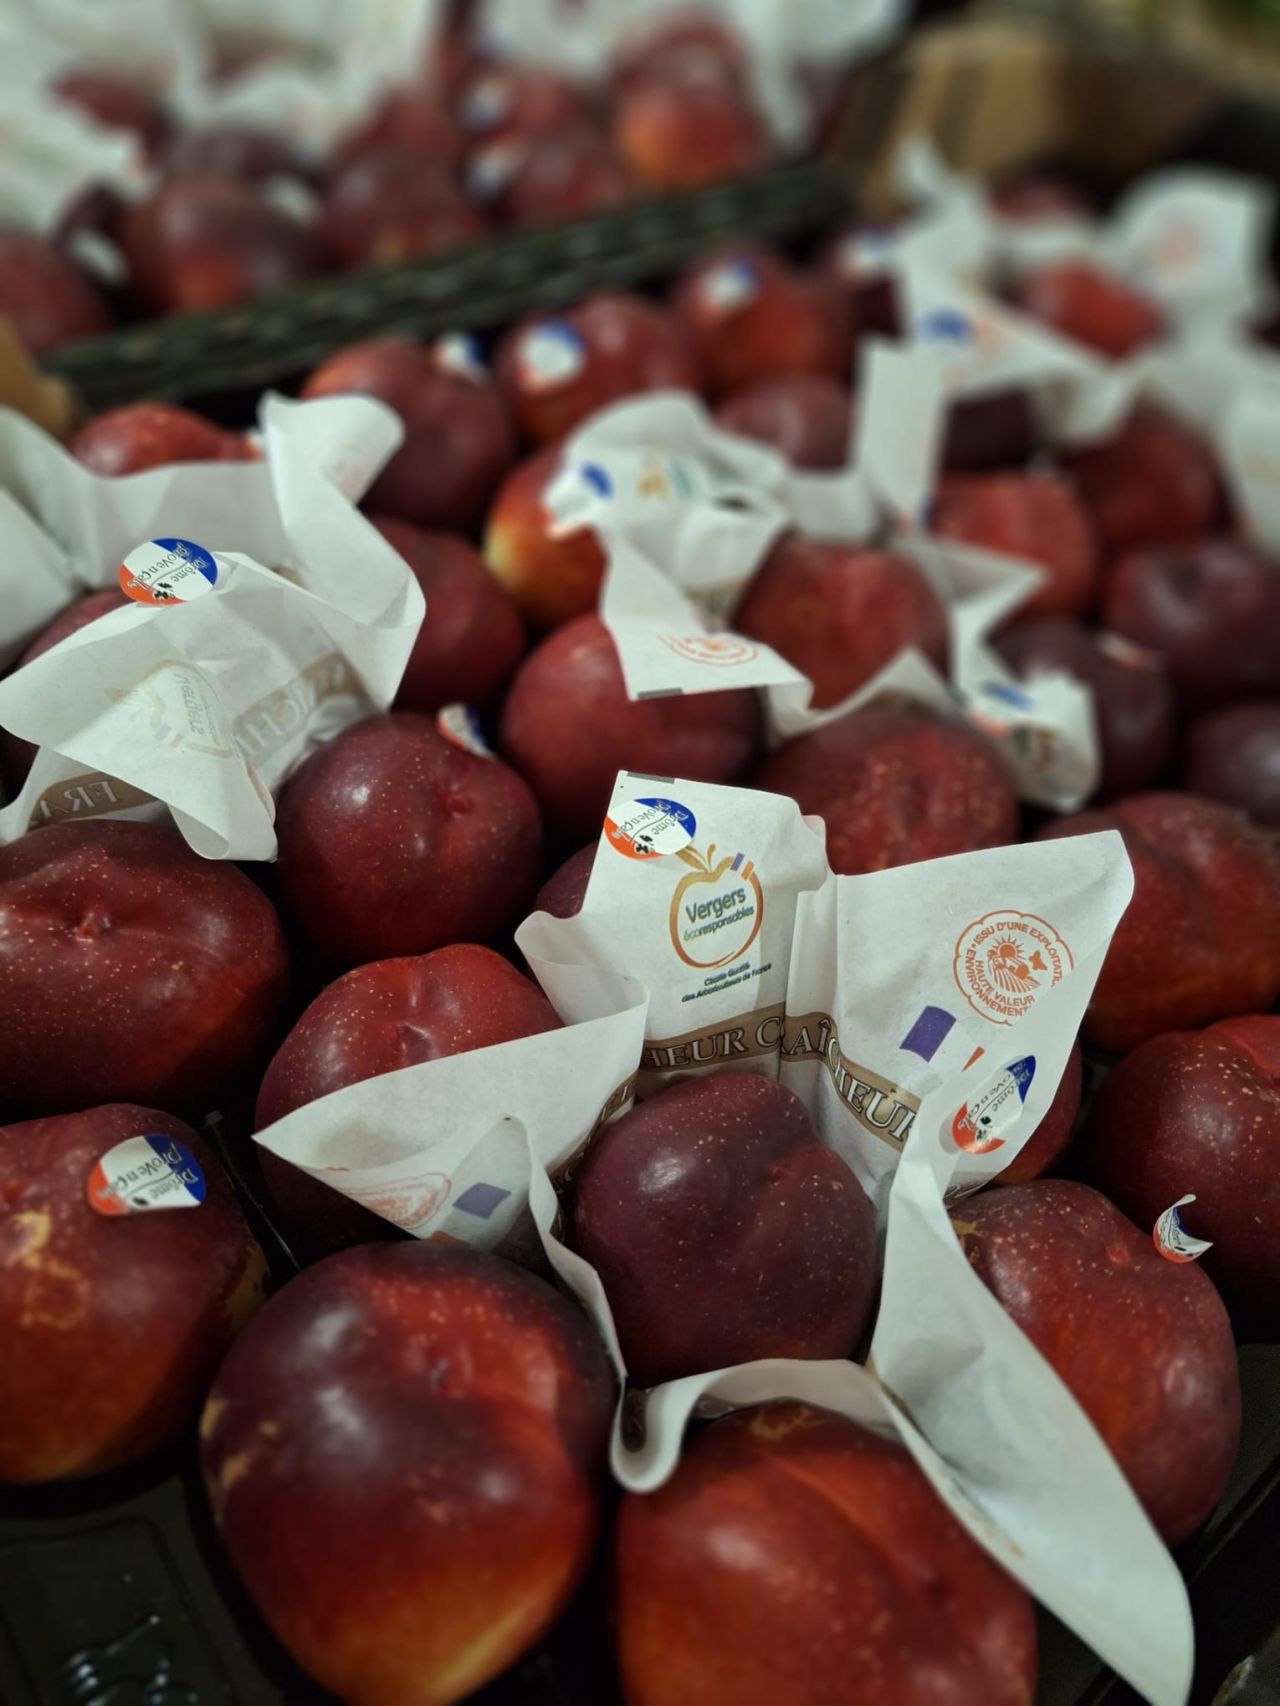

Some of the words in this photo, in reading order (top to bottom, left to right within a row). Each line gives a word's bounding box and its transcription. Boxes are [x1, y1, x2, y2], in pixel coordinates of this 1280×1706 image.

[650, 810, 689, 835] Drôme
[686, 888, 746, 923] Vergers
[684, 906, 754, 942] écoresponsables
[973, 925, 996, 945] ISSU
[996, 921, 1030, 933] D'UNE
[975, 960, 995, 995] HAUTE
[994, 992, 1036, 1007] VALEUR
